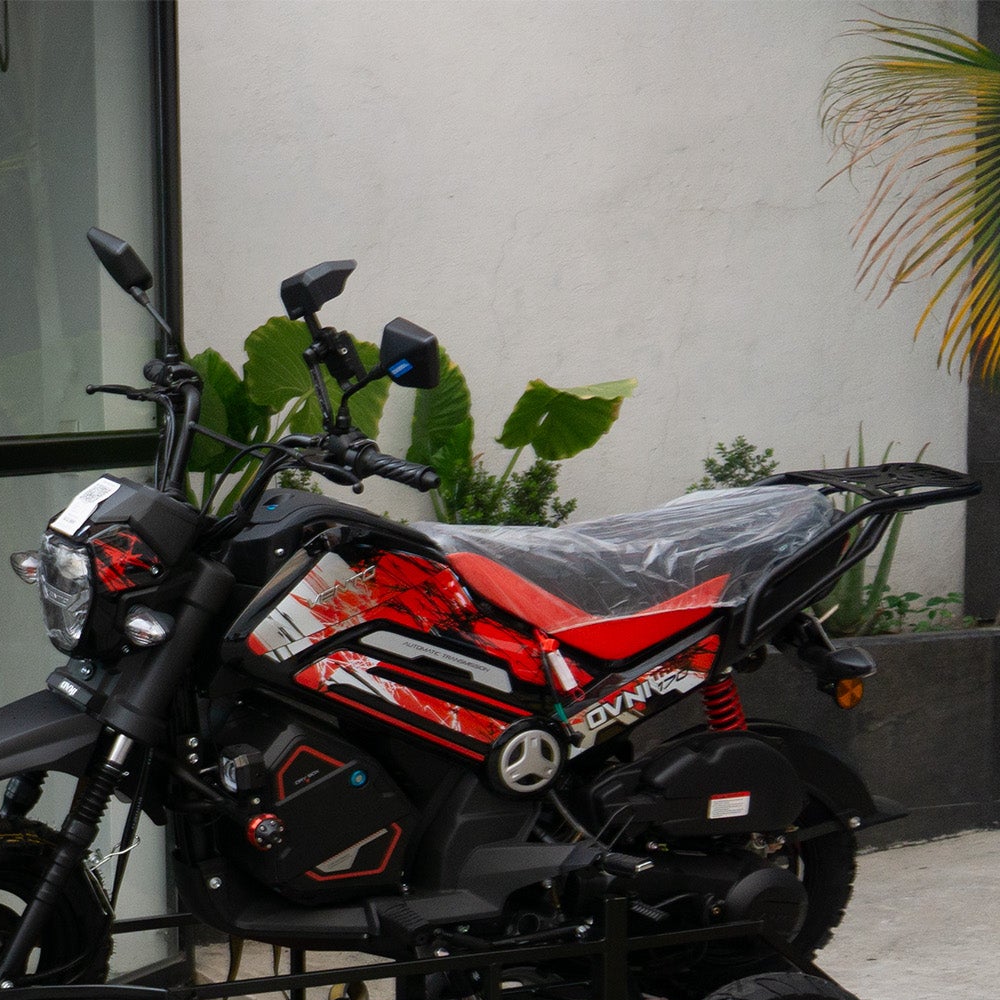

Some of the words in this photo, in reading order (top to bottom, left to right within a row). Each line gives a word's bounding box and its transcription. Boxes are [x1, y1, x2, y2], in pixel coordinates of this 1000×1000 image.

[402, 640, 440, 657] AUTOMATIC
[442, 653, 490, 673] TRANSMISSION
[586, 681, 652, 730] OVNI
[658, 669, 688, 692] 170
